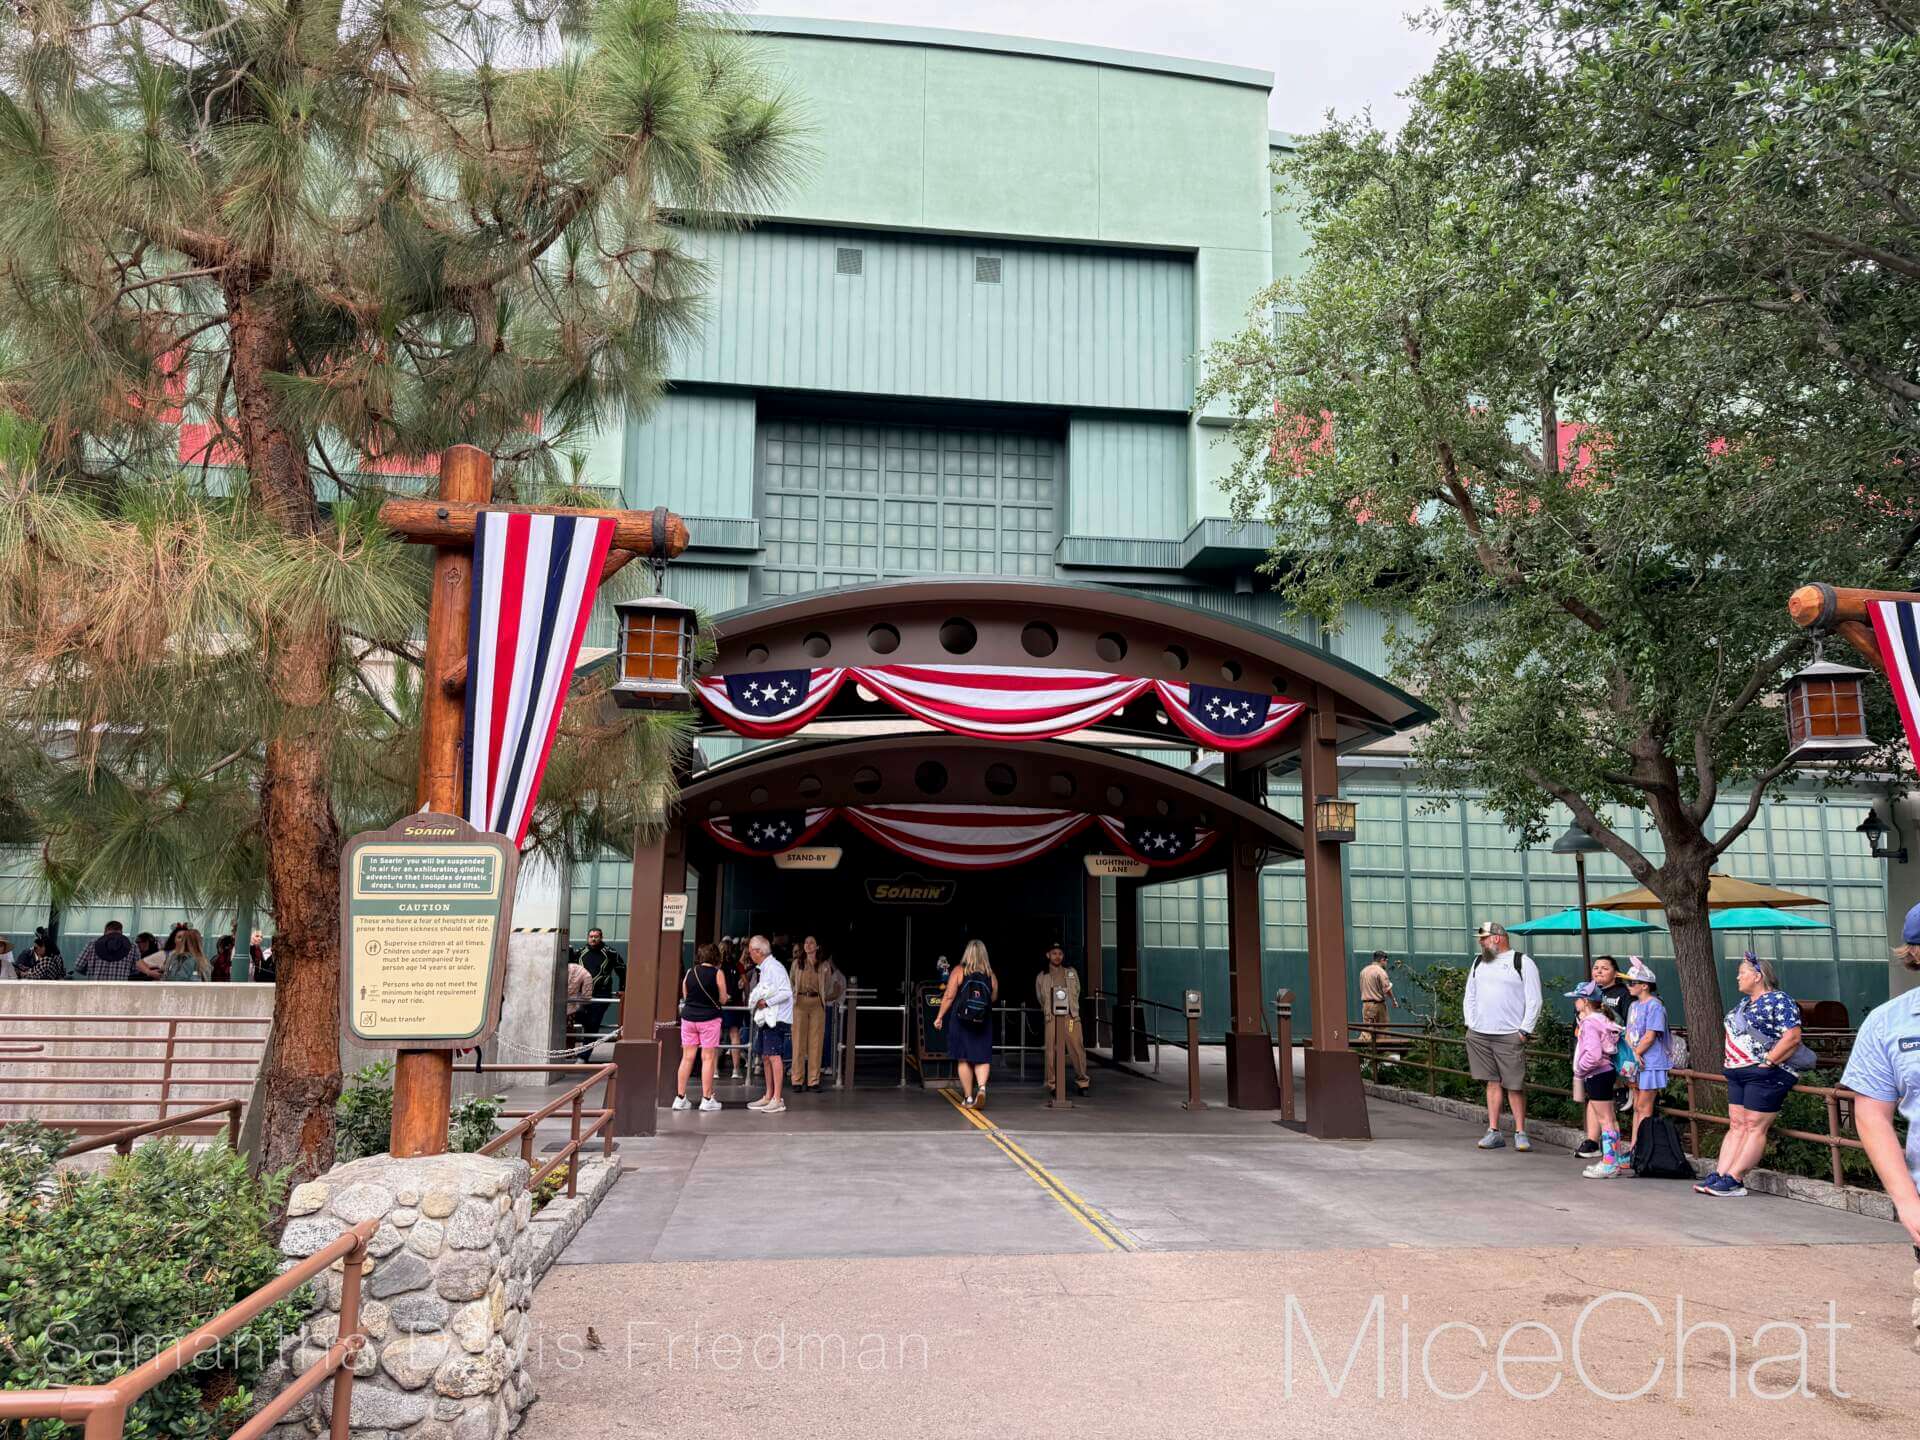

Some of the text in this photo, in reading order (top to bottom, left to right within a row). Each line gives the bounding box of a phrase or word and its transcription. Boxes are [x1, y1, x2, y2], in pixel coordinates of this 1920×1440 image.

[447, 858, 486, 866] suspended
[787, 854, 827, 862] STAND-BY
[399, 904, 450, 912] CAUTION
[442, 918, 467, 926] heights
